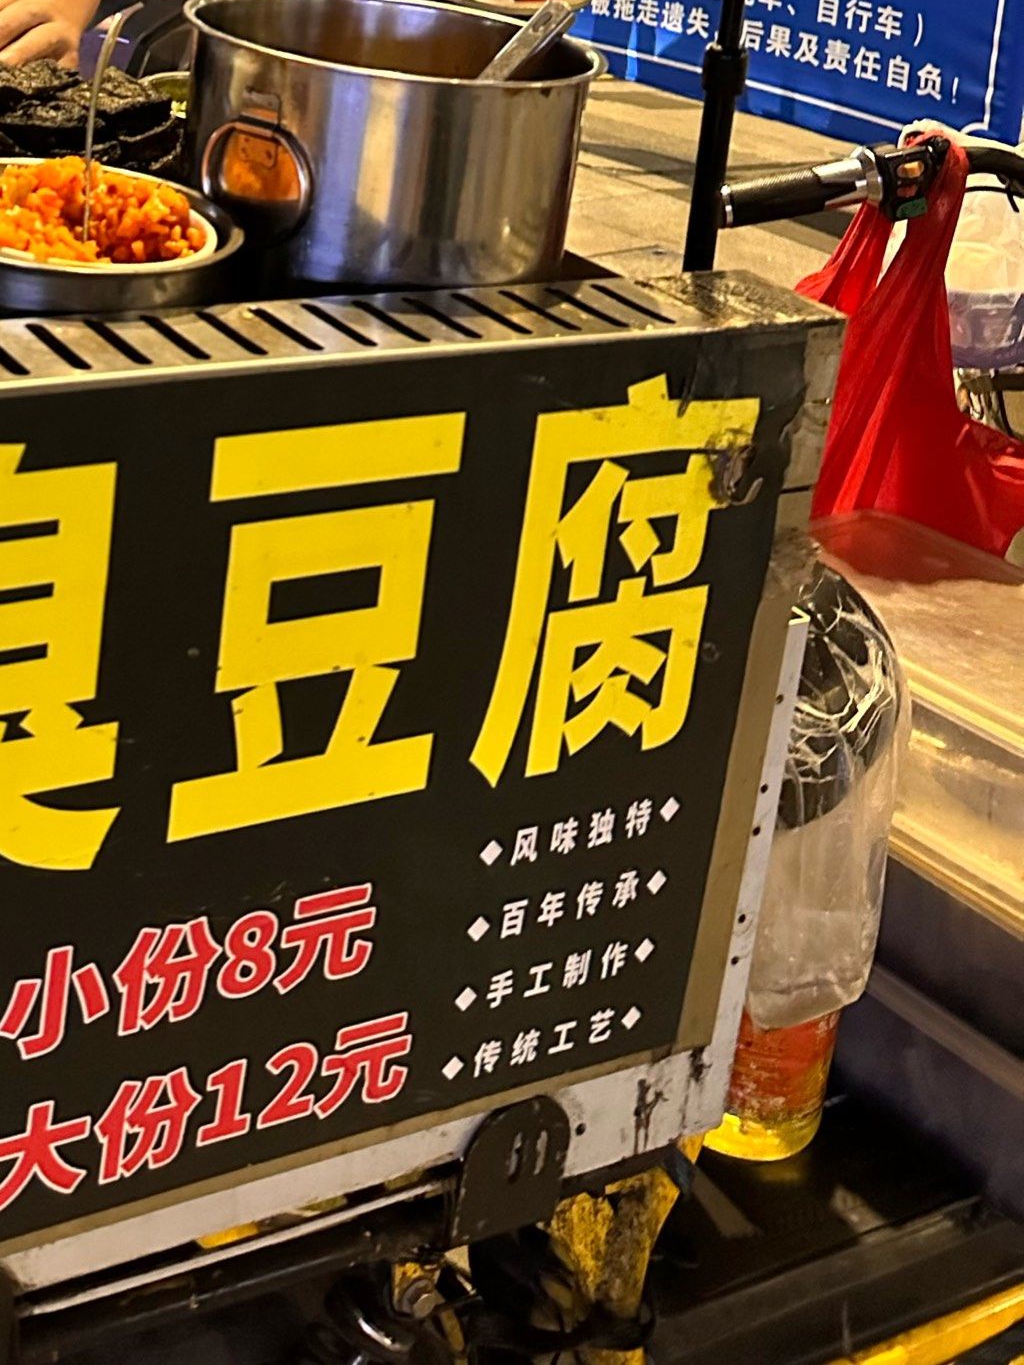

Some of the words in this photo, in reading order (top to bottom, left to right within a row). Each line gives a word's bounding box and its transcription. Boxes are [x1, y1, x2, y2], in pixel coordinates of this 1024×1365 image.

[510, 798, 653, 867] 风味独特
[500, 869, 640, 940] 百年传承
[486, 941, 629, 1010] 手工制作
[473, 1007, 616, 1078] 传统工艺
